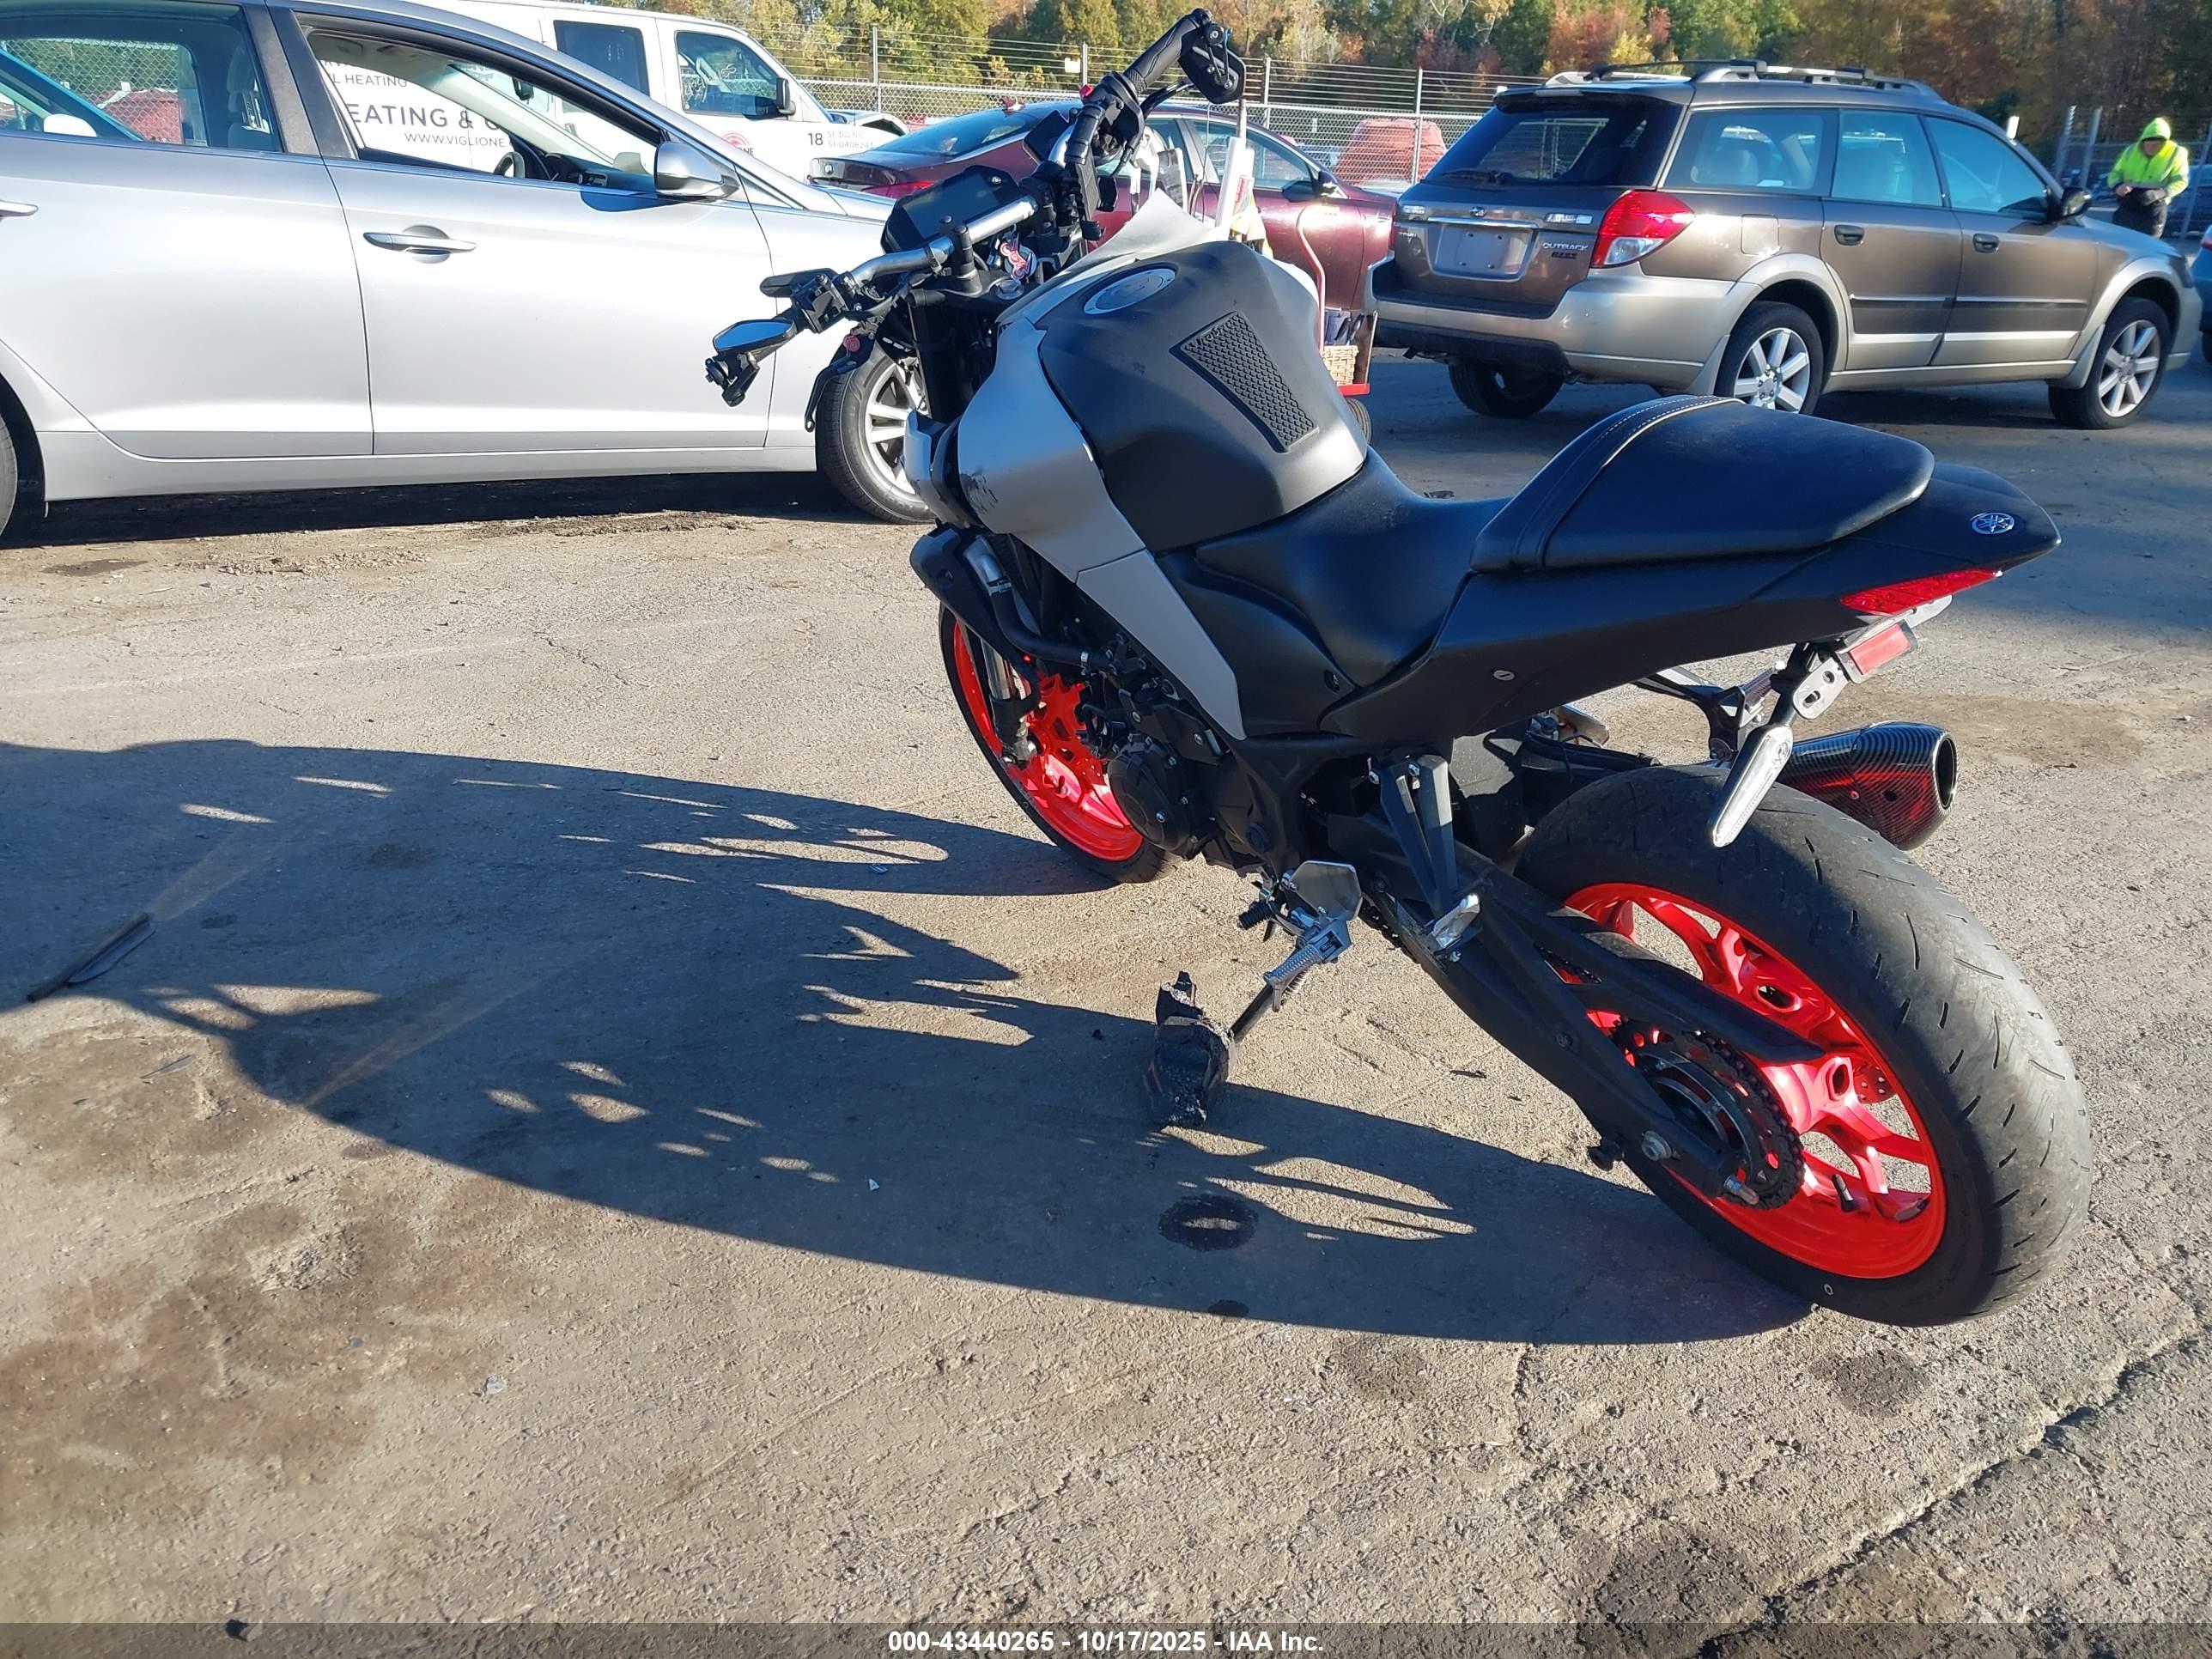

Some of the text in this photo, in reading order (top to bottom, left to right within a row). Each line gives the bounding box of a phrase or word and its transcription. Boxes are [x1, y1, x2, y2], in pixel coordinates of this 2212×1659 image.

[344, 74, 408, 87] HEATING
[458, 110, 474, 129] &
[807, 132, 824, 146] 18
